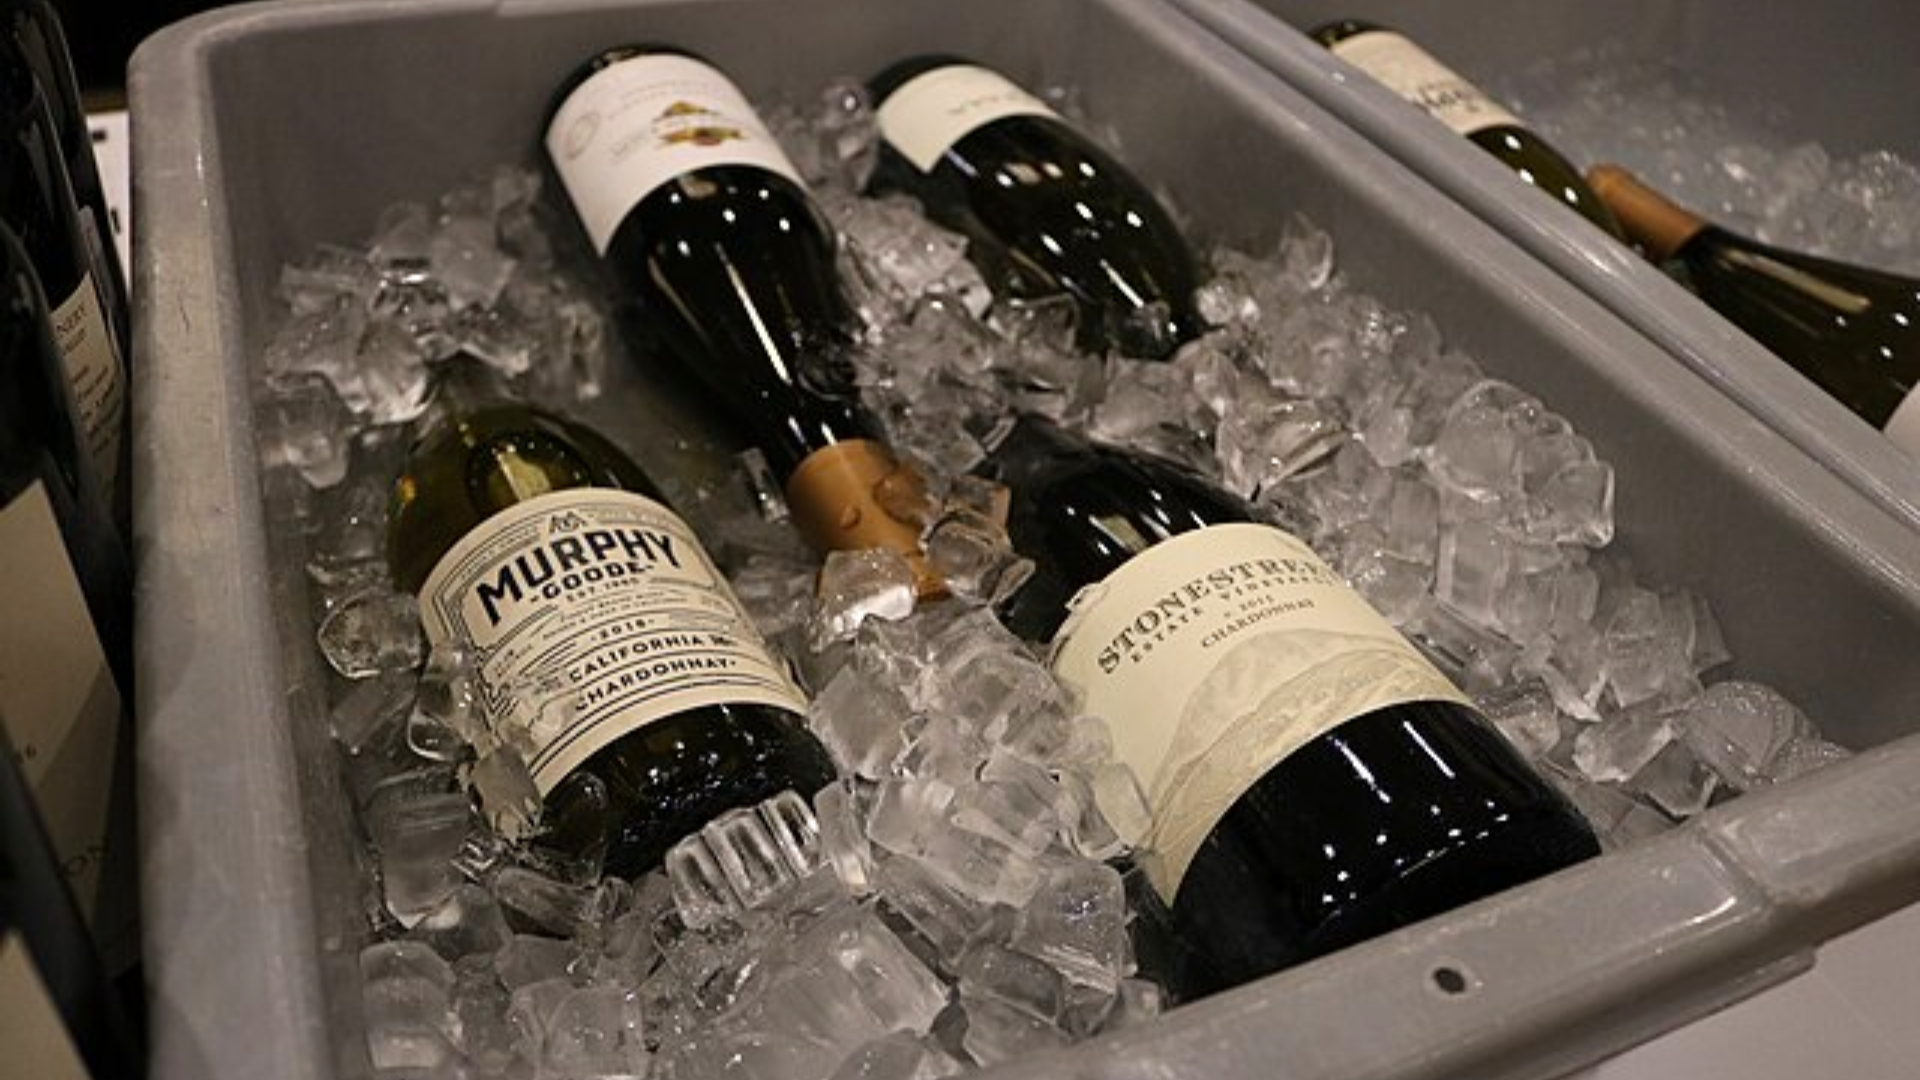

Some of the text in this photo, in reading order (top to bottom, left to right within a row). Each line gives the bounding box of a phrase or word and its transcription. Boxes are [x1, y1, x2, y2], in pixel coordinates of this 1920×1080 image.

[476, 529, 681, 627] MURPHY
[1130, 607, 1203, 662] ESTATE
[1201, 599, 1315, 647] CHARDONNAY
[568, 634, 703, 683] CALIFORNIA
